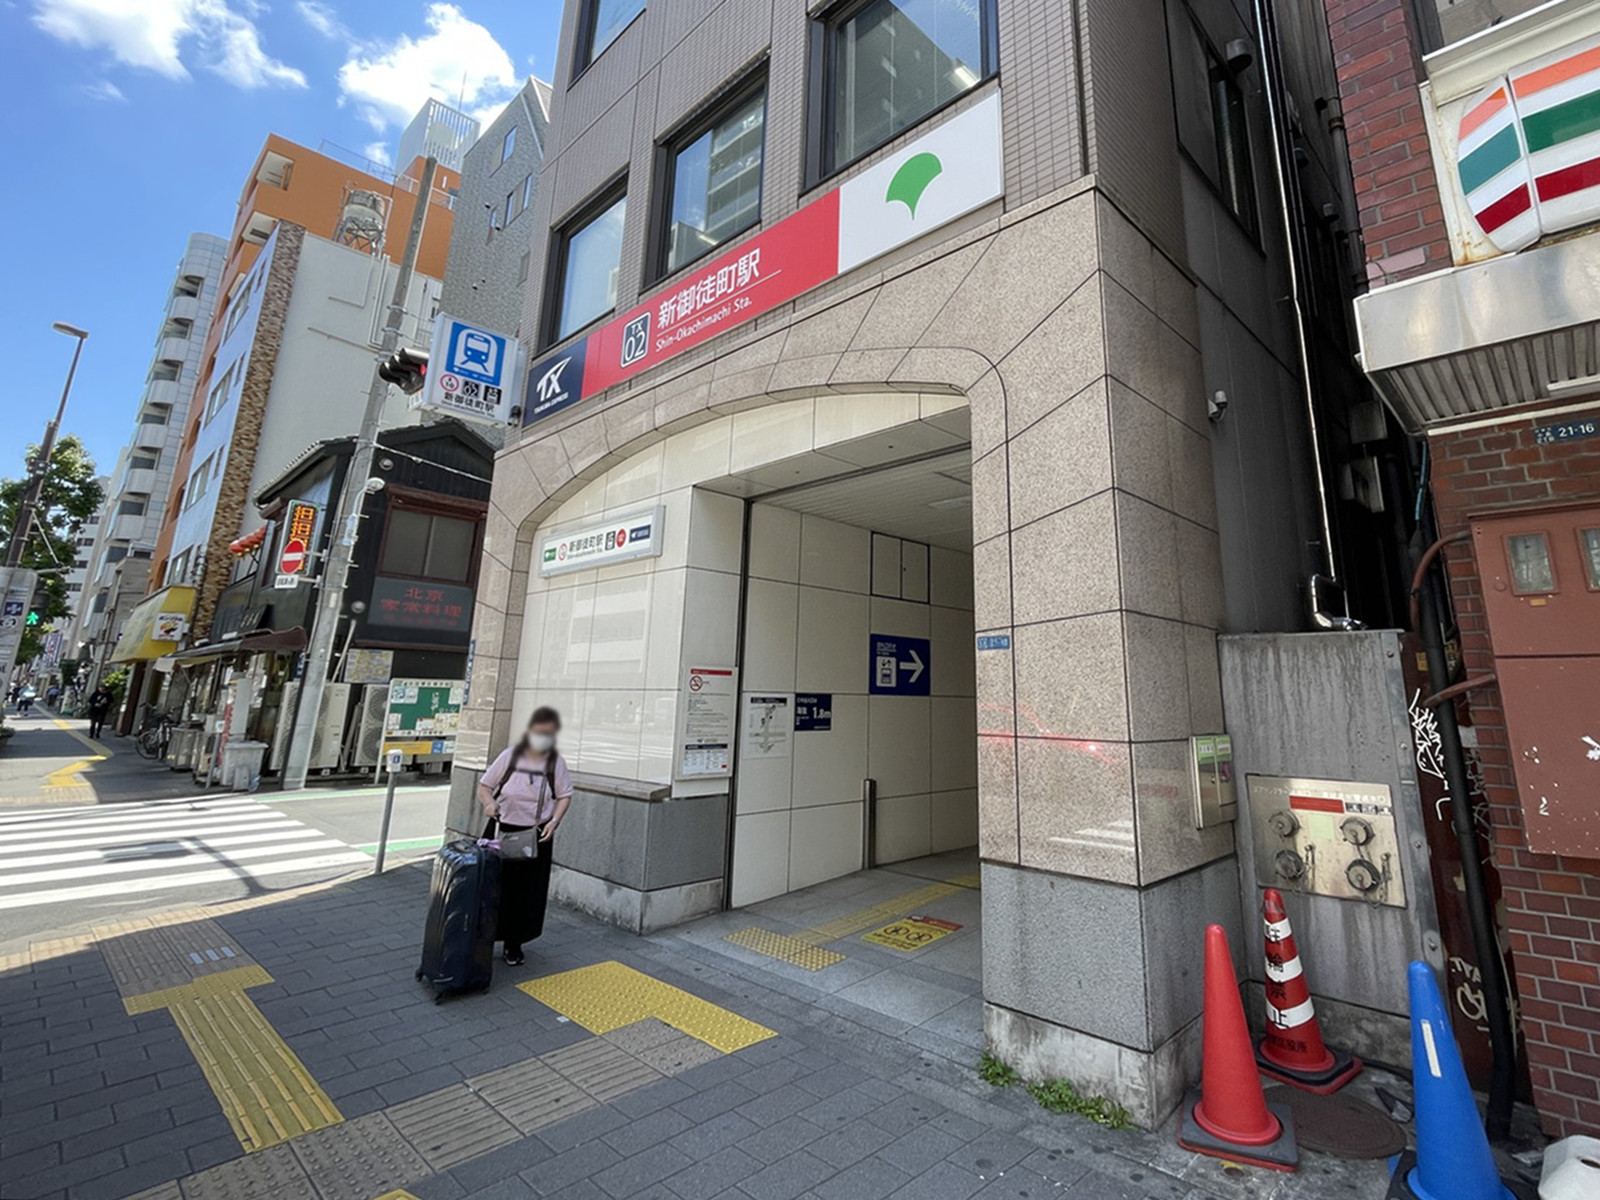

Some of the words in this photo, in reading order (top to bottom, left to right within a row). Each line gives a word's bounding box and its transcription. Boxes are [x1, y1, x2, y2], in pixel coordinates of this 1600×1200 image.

[657, 247, 761, 329] 新御徒町駅
[629, 319, 645, 335] TX
[655, 302, 732, 353] Shin-Okachimachi
[733, 296, 753, 313] Sta.
[623, 332, 647, 362] 02
[536, 356, 573, 402] TX
[1558, 422, 1595, 438] 21-16
[404, 586, 444, 601] 北京
